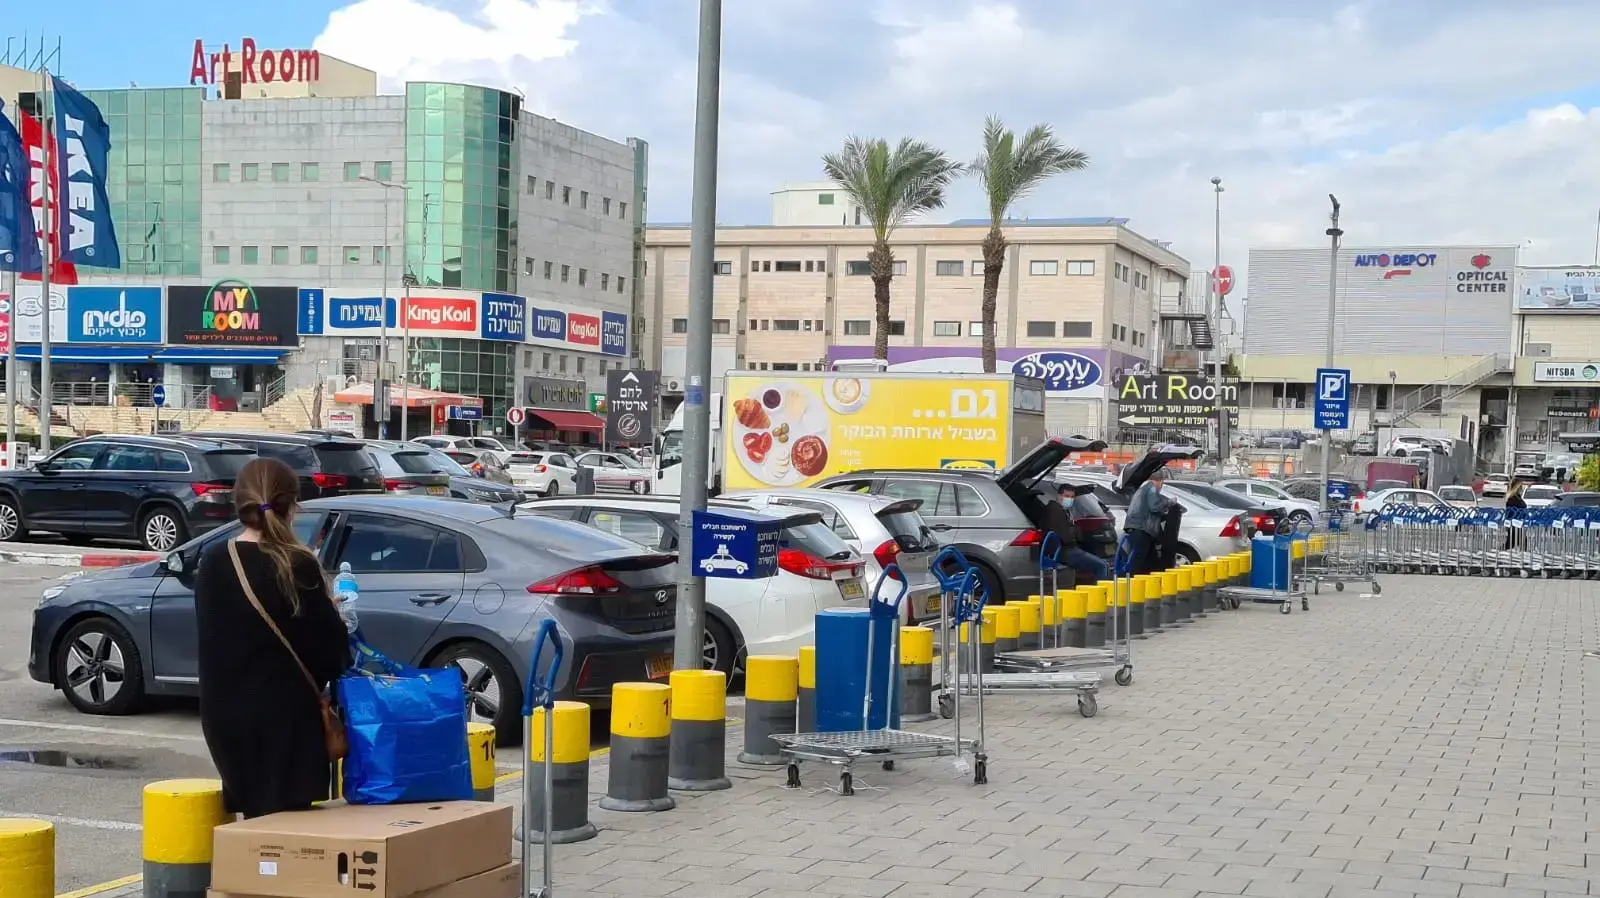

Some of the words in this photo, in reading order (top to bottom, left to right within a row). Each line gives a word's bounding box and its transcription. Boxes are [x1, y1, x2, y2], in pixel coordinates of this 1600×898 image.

[190, 39, 231, 85] Art
[242, 37, 319, 83] Room
[64, 113, 96, 251] IKEA
[1354, 254, 1390, 267] AUTO
[1393, 253, 1437, 267] DEPOT
[1456, 271, 1508, 281] OPTICAL
[1456, 283, 1506, 293] CENTER
[213, 288, 248, 311] MY
[340, 304, 385, 321] עמינח
[407, 304, 440, 324] King
[442, 305, 472, 322] Koil
[487, 300, 523, 318] גלריית
[202, 311, 260, 331] ROOM
[488, 317, 523, 334] השינה
[537, 315, 561, 333] עמינח
[570, 320, 586, 339] King
[603, 320, 624, 333] גלריית
[89, 328, 114, 337] זיקים
[119, 328, 146, 337] קיבוץ
[604, 333, 624, 347] השינה
[1546, 367, 1575, 376] NITSBA
[620, 385, 642, 398] לחם
[1120, 375, 1158, 400] Art
[1167, 375, 1237, 400] Room
[612, 400, 648, 413] ארטיזן
[839, 425, 886, 442] הבוקר
[891, 426, 943, 440] ארוחת
[948, 425, 997, 442] בשביל
